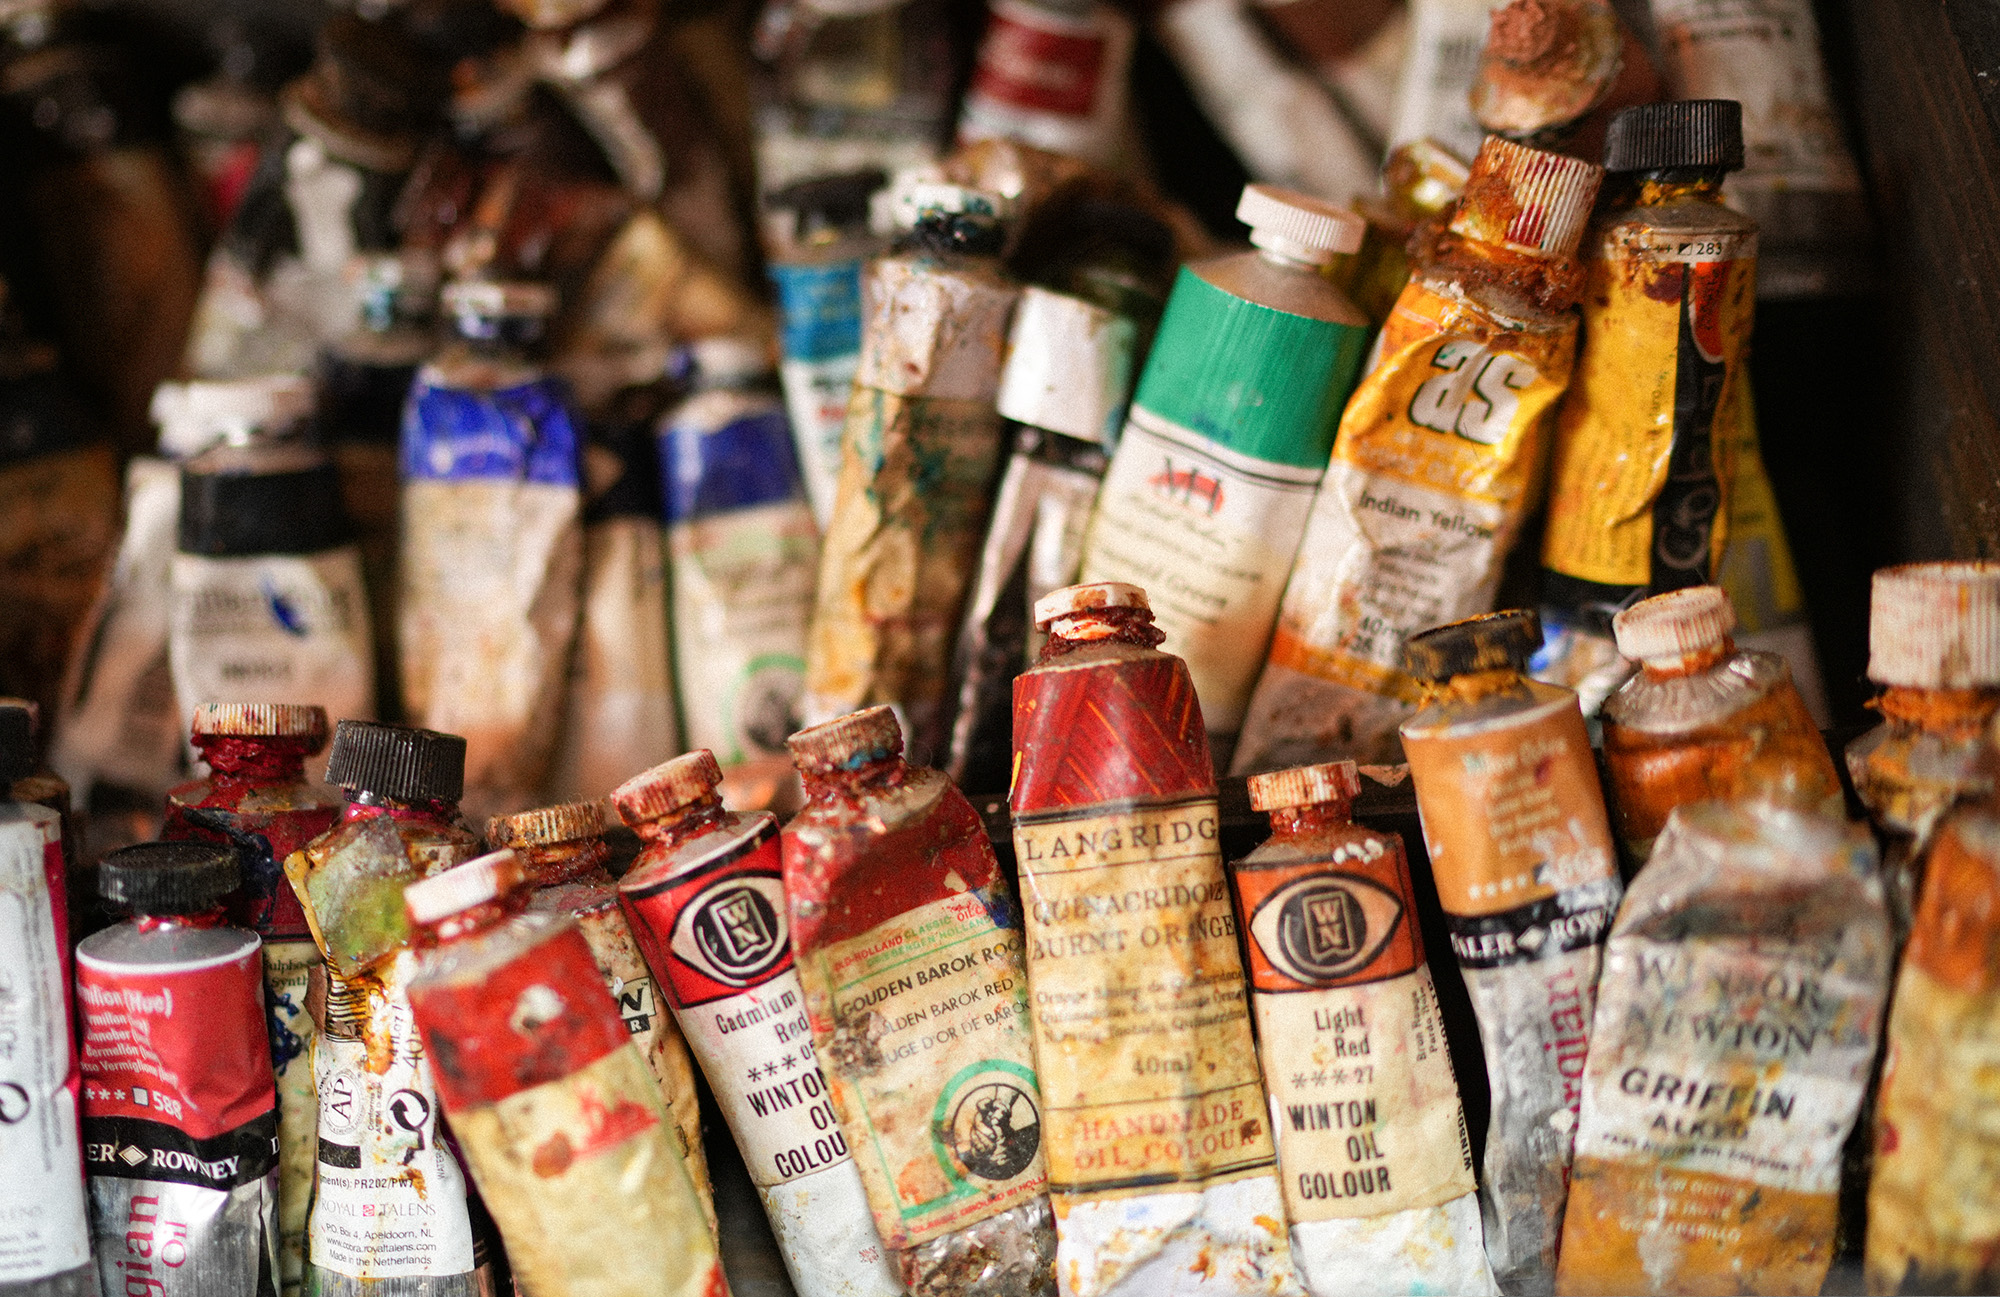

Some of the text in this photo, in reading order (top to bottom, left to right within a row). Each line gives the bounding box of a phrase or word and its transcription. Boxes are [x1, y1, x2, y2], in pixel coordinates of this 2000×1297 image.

[1697, 242, 1722, 255] 283
[1359, 489, 1494, 540] Indian Yellow
[916, 952, 979, 986] BAROK
[715, 989, 797, 1035] Cadmium
[930, 988, 982, 1018] BAROK
[983, 977, 1014, 998] RED
[773, 1011, 810, 1044] Red
[921, 1026, 959, 1050] D'OR
[960, 1017, 981, 1036] DE
[1314, 1007, 1366, 1034] Light
[1333, 1035, 1371, 1059] Red
[152, 1090, 183, 1121] 588
[1619, 1067, 1796, 1121] GRIFFIN
[1287, 1099, 1378, 1132] WINTON
[151, 1147, 241, 1181] ROWNEY
[1347, 1135, 1385, 1164] OIL
[1298, 1167, 1393, 1201] COLOUR
[320, 1197, 437, 1217] ROYAL TALENS
[161, 1220, 188, 1269] Oil
[420, 1228, 434, 1239] NL
[328, 1248, 347, 1262] Made
[356, 1255, 371, 1267] the
[373, 1254, 432, 1267] Netherlands
